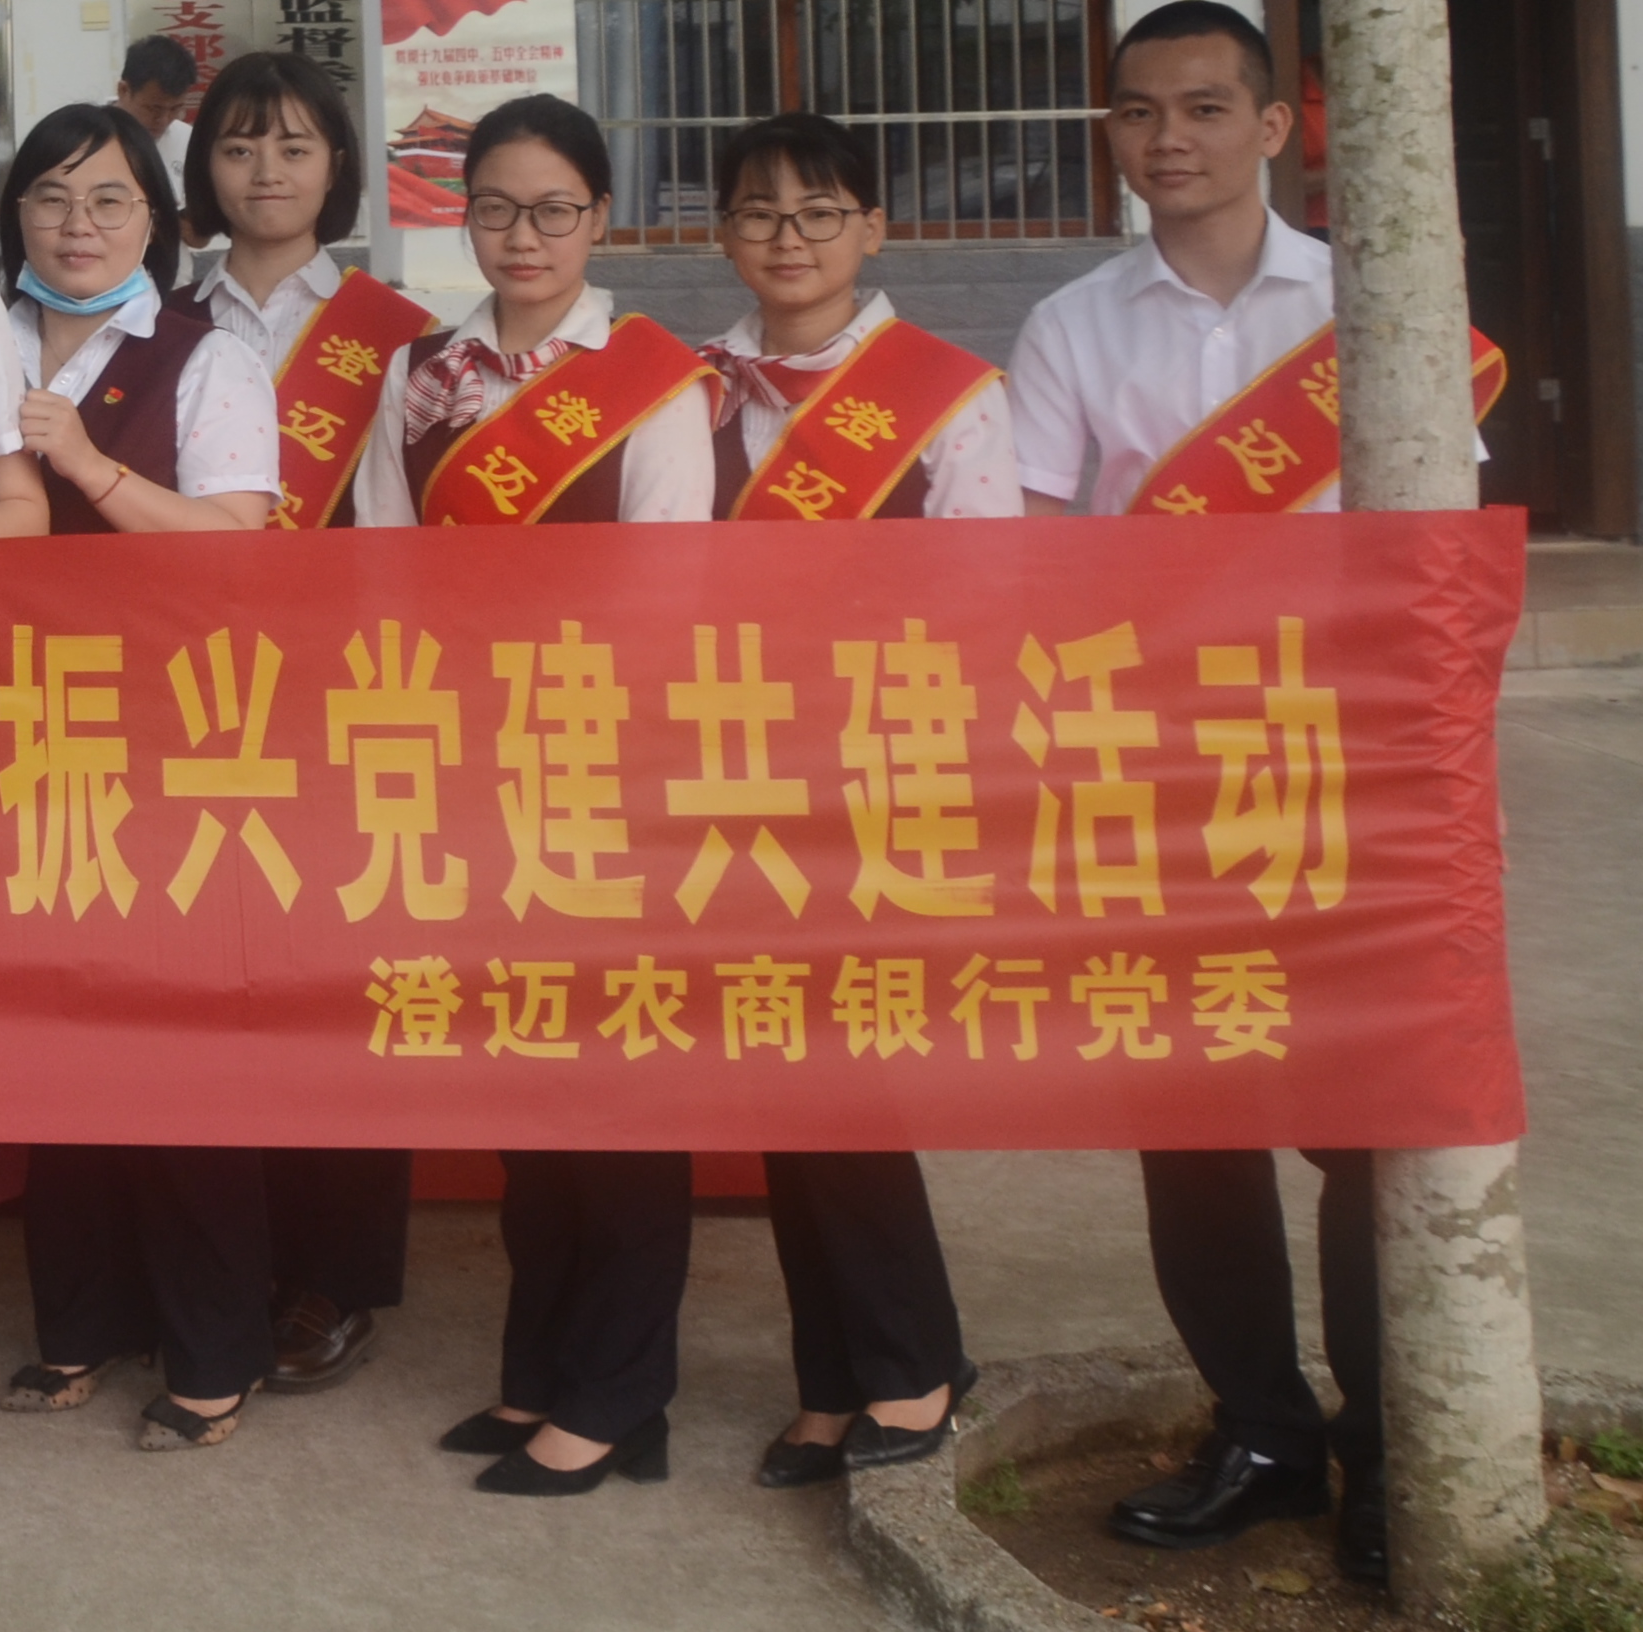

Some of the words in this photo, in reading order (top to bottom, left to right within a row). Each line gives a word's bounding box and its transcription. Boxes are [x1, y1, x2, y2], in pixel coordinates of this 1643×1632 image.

[768, 396, 897, 520] 澄迈
[364, 948, 1292, 1063] 澄迈农商银行党委
